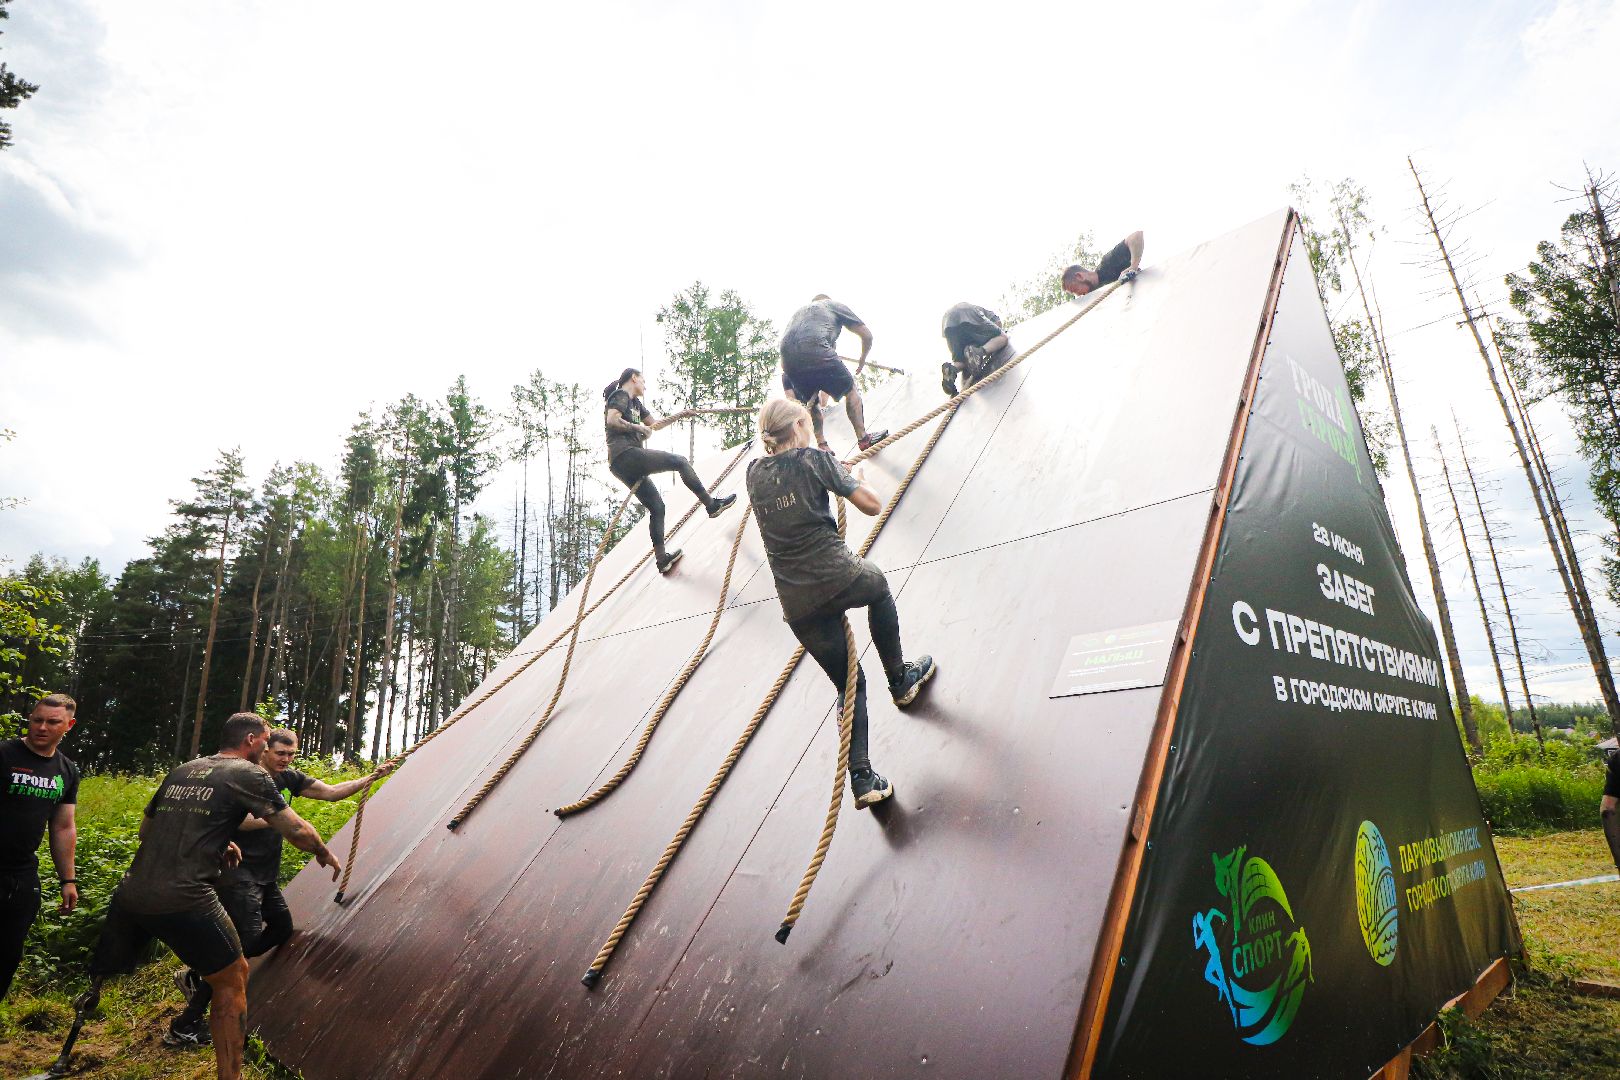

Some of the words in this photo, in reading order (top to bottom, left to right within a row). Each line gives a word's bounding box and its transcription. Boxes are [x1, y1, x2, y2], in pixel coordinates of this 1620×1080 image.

[1330, 532, 1365, 566] ИЮНЯ
[1316, 563, 1376, 617] ЗАБЕГ
[1232, 601, 1260, 646] С
[1265, 608, 1440, 689] ПРЕПЯТСТВИЯМИ
[1272, 675, 1288, 702] В
[1290, 678, 1373, 712] ГОРОДСКОМ
[1373, 692, 1412, 717] ОКРУГЕ
[1412, 702, 1438, 721] КЛИН
[11, 772, 58, 789] ТРОПА
[1399, 829, 1446, 874] ПАРКОВЫЙ
[1248, 910, 1276, 936] КЛИН
[1232, 930, 1282, 978] СПОРТ
